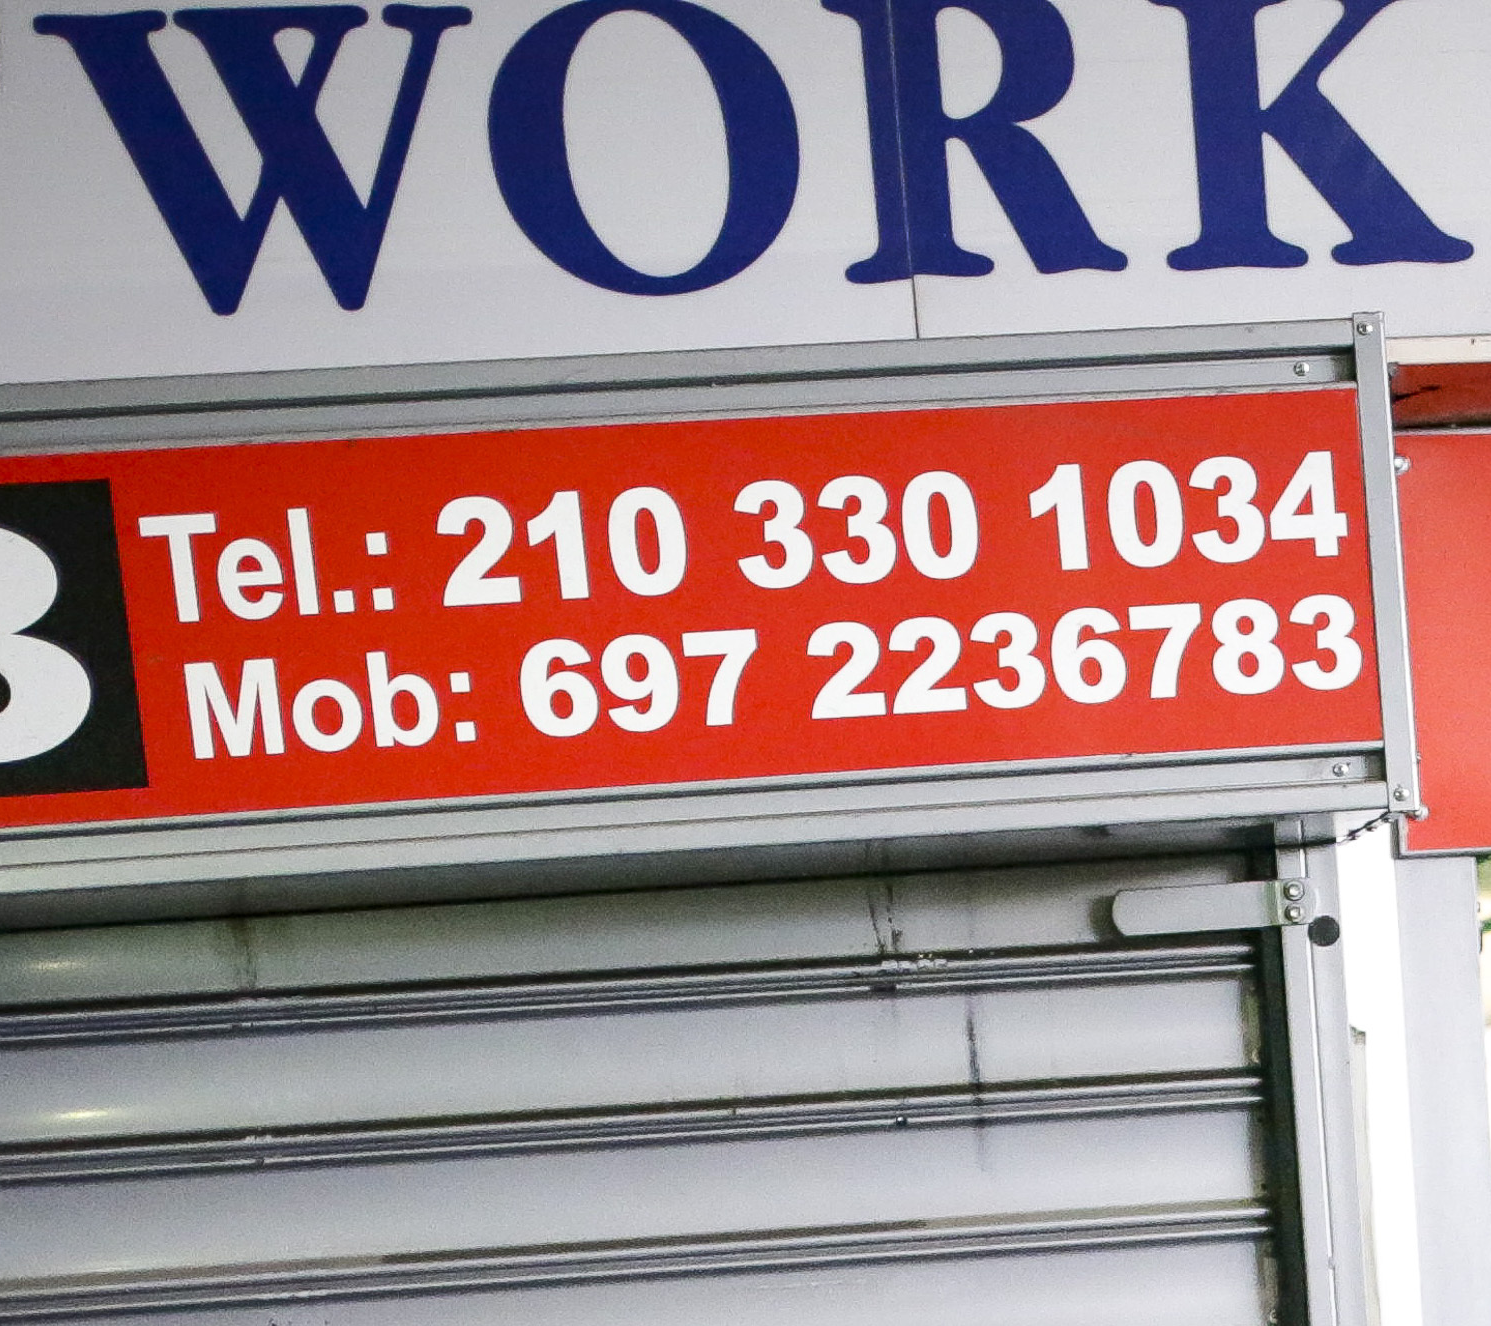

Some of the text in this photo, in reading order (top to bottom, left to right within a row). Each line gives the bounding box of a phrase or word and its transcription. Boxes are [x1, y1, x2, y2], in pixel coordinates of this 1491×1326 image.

[138, 450, 1348, 623] Tel.: 210 330 1034
[183, 594, 1363, 760] Mob: 697 2236783
